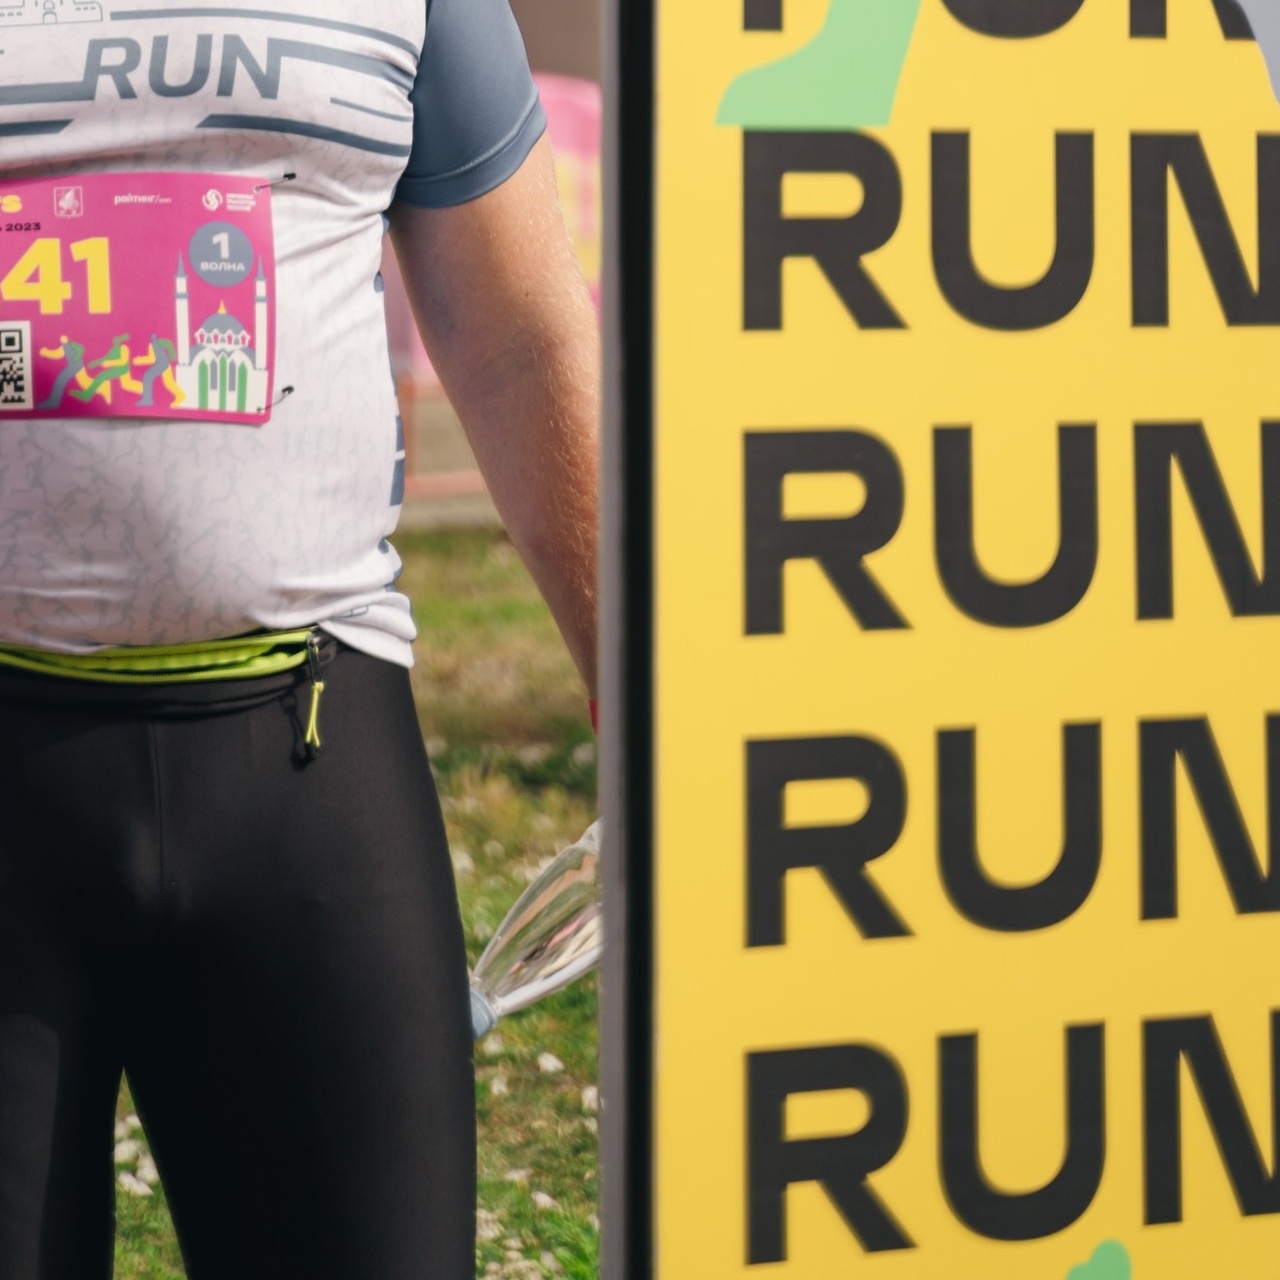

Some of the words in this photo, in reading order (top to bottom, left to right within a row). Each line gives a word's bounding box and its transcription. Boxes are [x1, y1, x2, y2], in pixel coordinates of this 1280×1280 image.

[82, 32, 282, 100] RUN
[5, 222, 41, 233] 2023
[200, 260, 246, 272] ВОЛНА
[212, 232, 230, 259] 1
[742, 128, 1280, 331] RUN
[743, 417, 1280, 636] RUN
[743, 709, 1280, 949] RUN
[743, 1005, 1280, 1266] RUN
